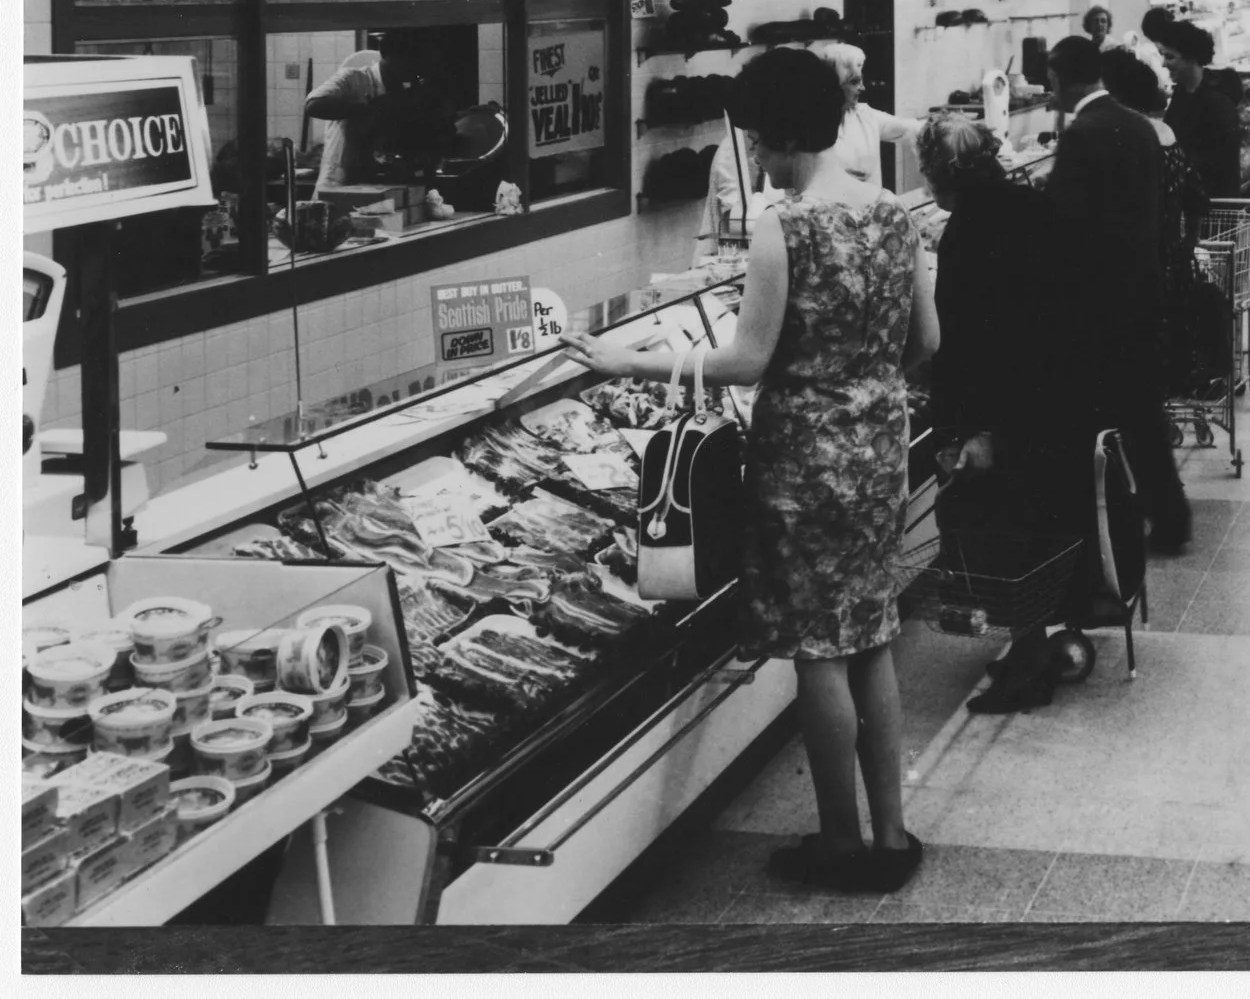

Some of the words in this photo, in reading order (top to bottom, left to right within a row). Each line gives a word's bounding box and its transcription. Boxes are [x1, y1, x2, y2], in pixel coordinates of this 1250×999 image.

[54, 113, 184, 168] CHOICE
[438, 299, 491, 329] Scottish
[495, 294, 528, 323] Pride
[534, 302, 553, 317] Per
[446, 348, 458, 359] IN
[460, 339, 490, 356] PRICE
[450, 332, 484, 348] DOWN
